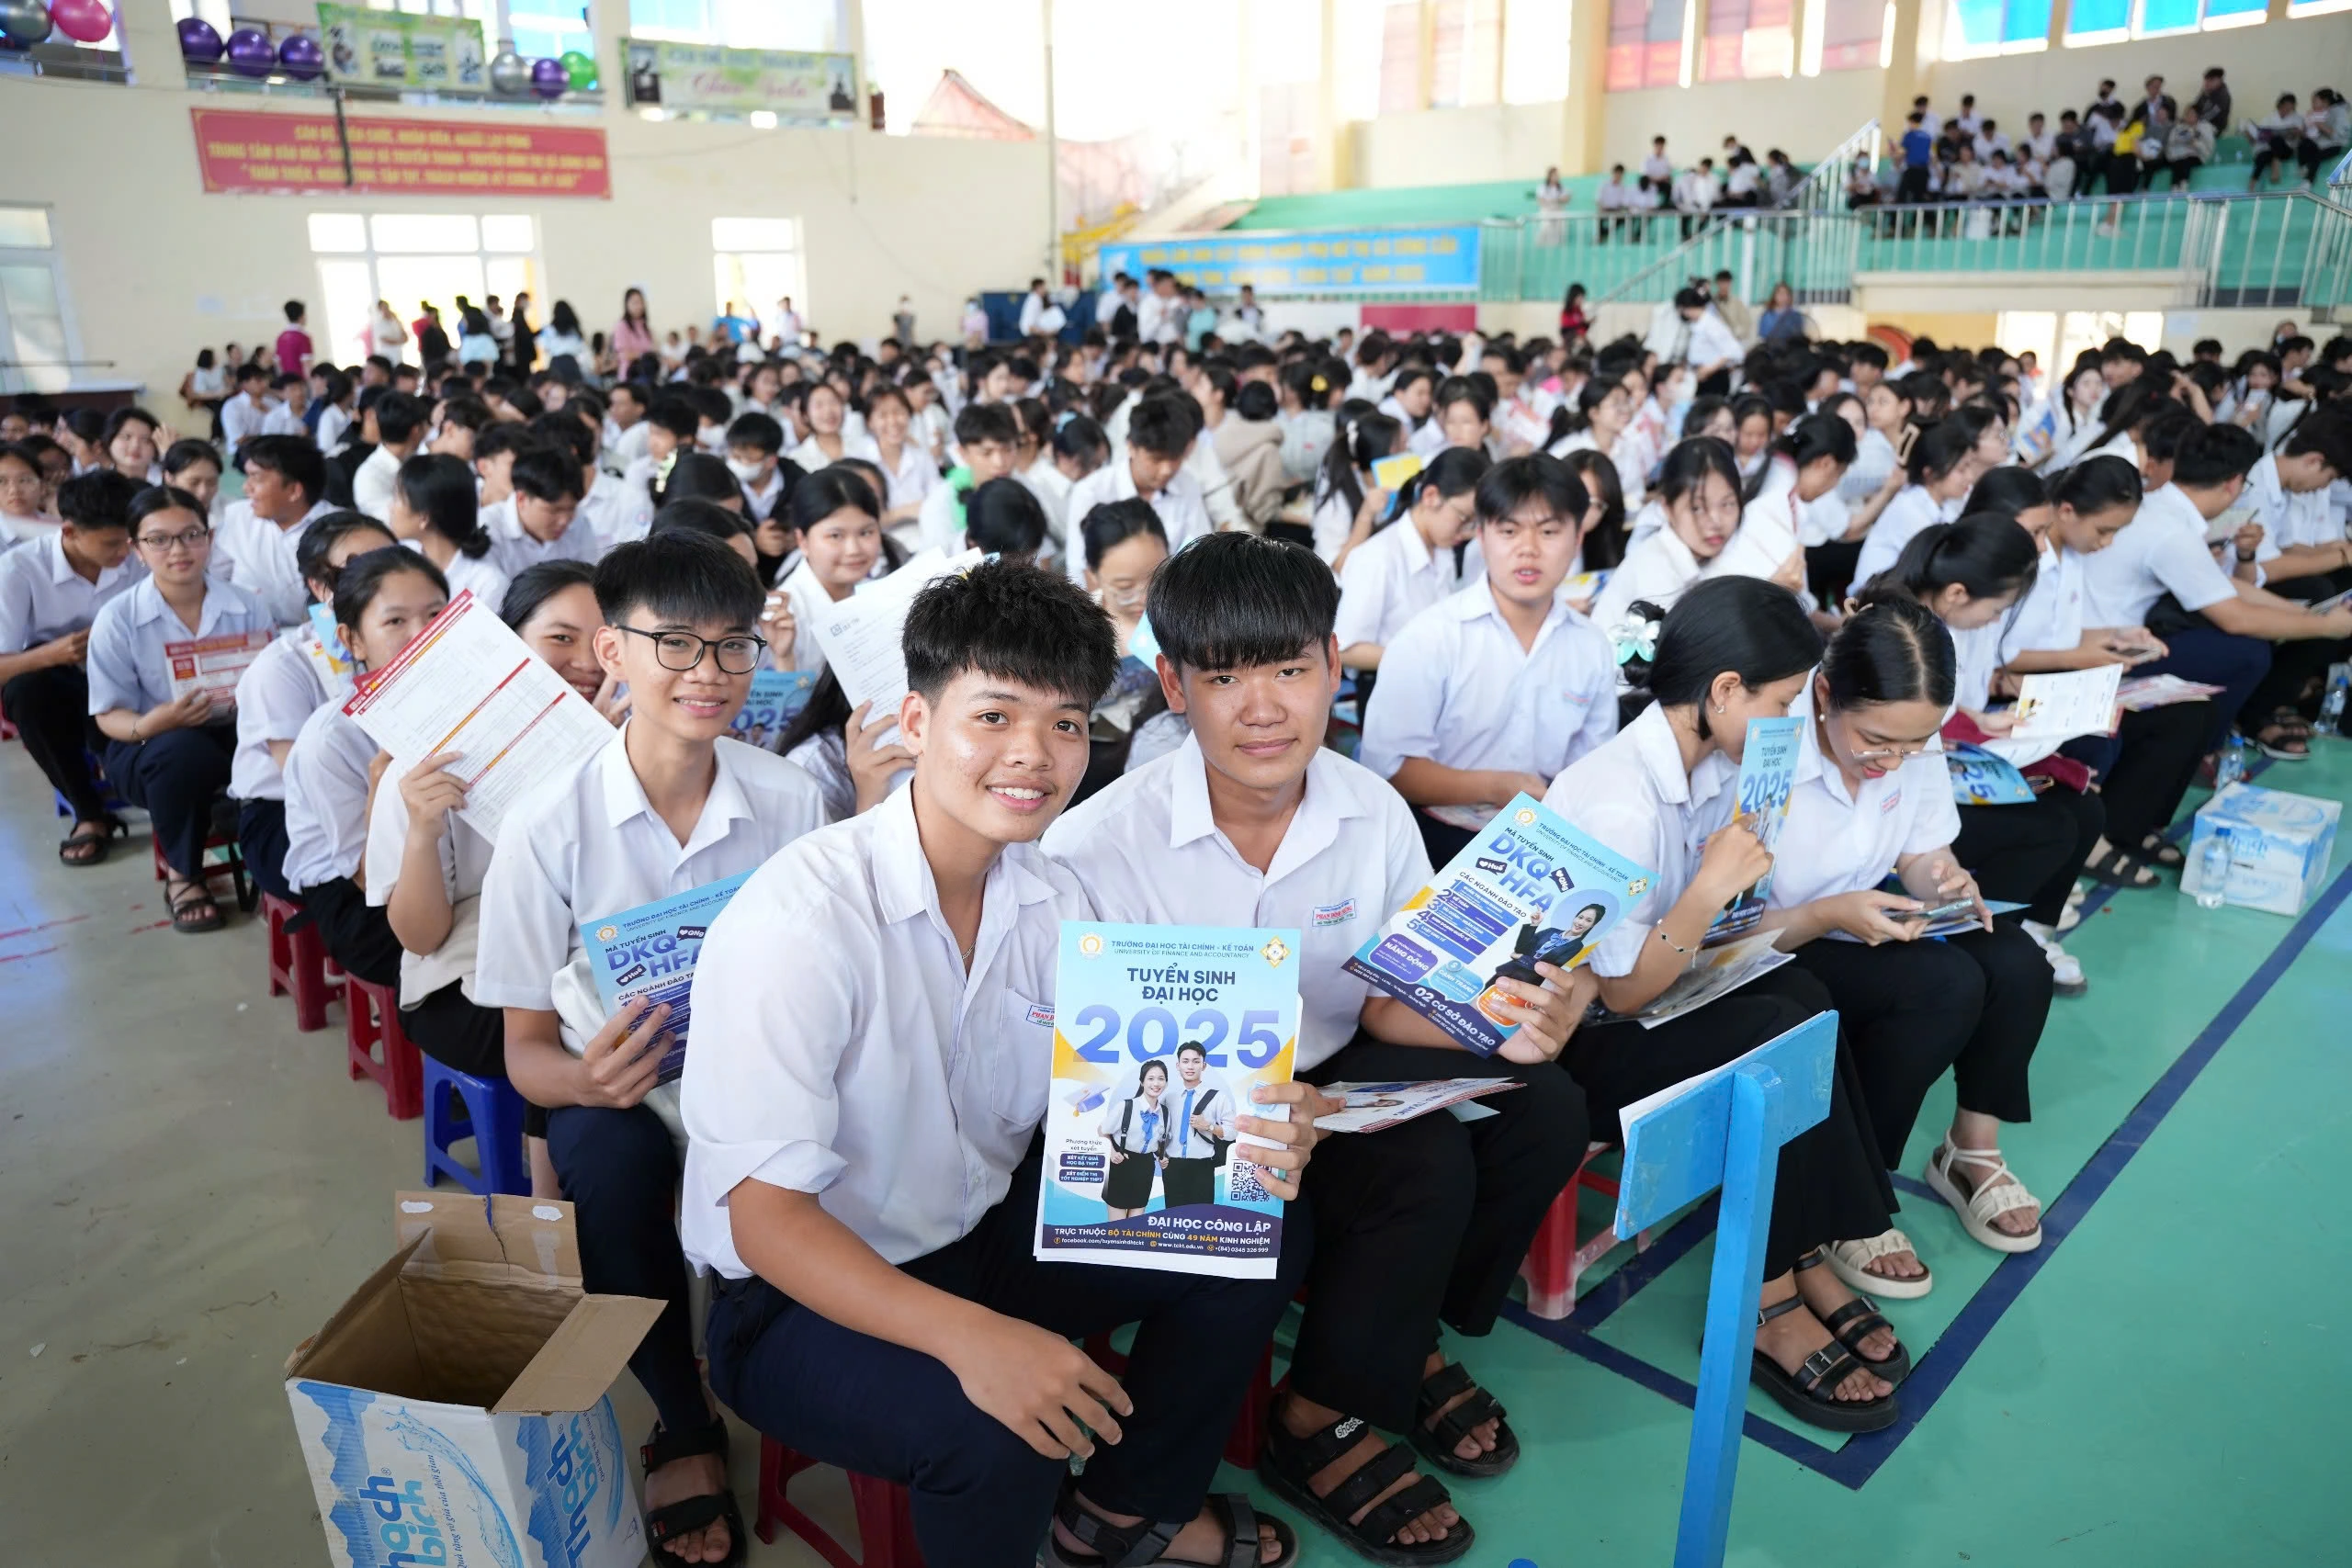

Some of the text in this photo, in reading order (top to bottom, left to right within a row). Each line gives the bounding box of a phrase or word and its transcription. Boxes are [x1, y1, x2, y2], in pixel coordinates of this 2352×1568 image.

[1741, 770, 1792, 813] 2025
[1487, 830, 1552, 882] DKQ
[1537, 849, 1555, 861] SINH
[1436, 887, 1453, 901] 2
[1498, 867, 1555, 913] HFA
[1414, 907, 1432, 921] 4
[1425, 897, 1442, 912] 3
[647, 928, 666, 939] SINH
[1405, 918, 1422, 931] 5
[606, 935, 677, 971] DKQ
[1145, 942, 1158, 950] ĐẠI
[1159, 942, 1177, 951] HỌC
[1192, 942, 1215, 951] CHÍNH
[1234, 943, 1254, 952] TOÁN
[1384, 940, 1409, 957] NĂNG
[1404, 953, 1430, 972] ĐỘNG
[628, 965, 644, 980] Huế
[1126, 963, 1236, 985] TUYỂN SINH
[636, 980, 665, 996] NGÀNH
[666, 974, 684, 986] ĐÀO
[1142, 986, 1219, 1006] ĐẠI HỌC
[1412, 986, 1435, 1002] 02
[1430, 998, 1448, 1011] CƠ
[1442, 1006, 1463, 1021] SỞ
[1455, 1016, 1481, 1035] ĐÀO
[1474, 1032, 1497, 1048] TẠO
[1073, 1004, 1281, 1069] 2025
[1148, 1216, 1272, 1235] ĐẠI HỌC CÔNG LẬP
[1055, 1227, 1077, 1236] TRỰC
[1078, 1227, 1107, 1237] THUỘC
[1108, 1228, 1120, 1237] BỘ
[1122, 1229, 1134, 1237] TÀI
[1136, 1229, 1161, 1238] CHÍNH
[1162, 1231, 1186, 1240] CÙNG
[1199, 1234, 1218, 1243] NĂM
[1239, 1236, 1271, 1247] NGHIỆM
[1158, 1242, 1204, 1250] www.tckt.edu.vn
[428, 1454, 441, 1474] gian
